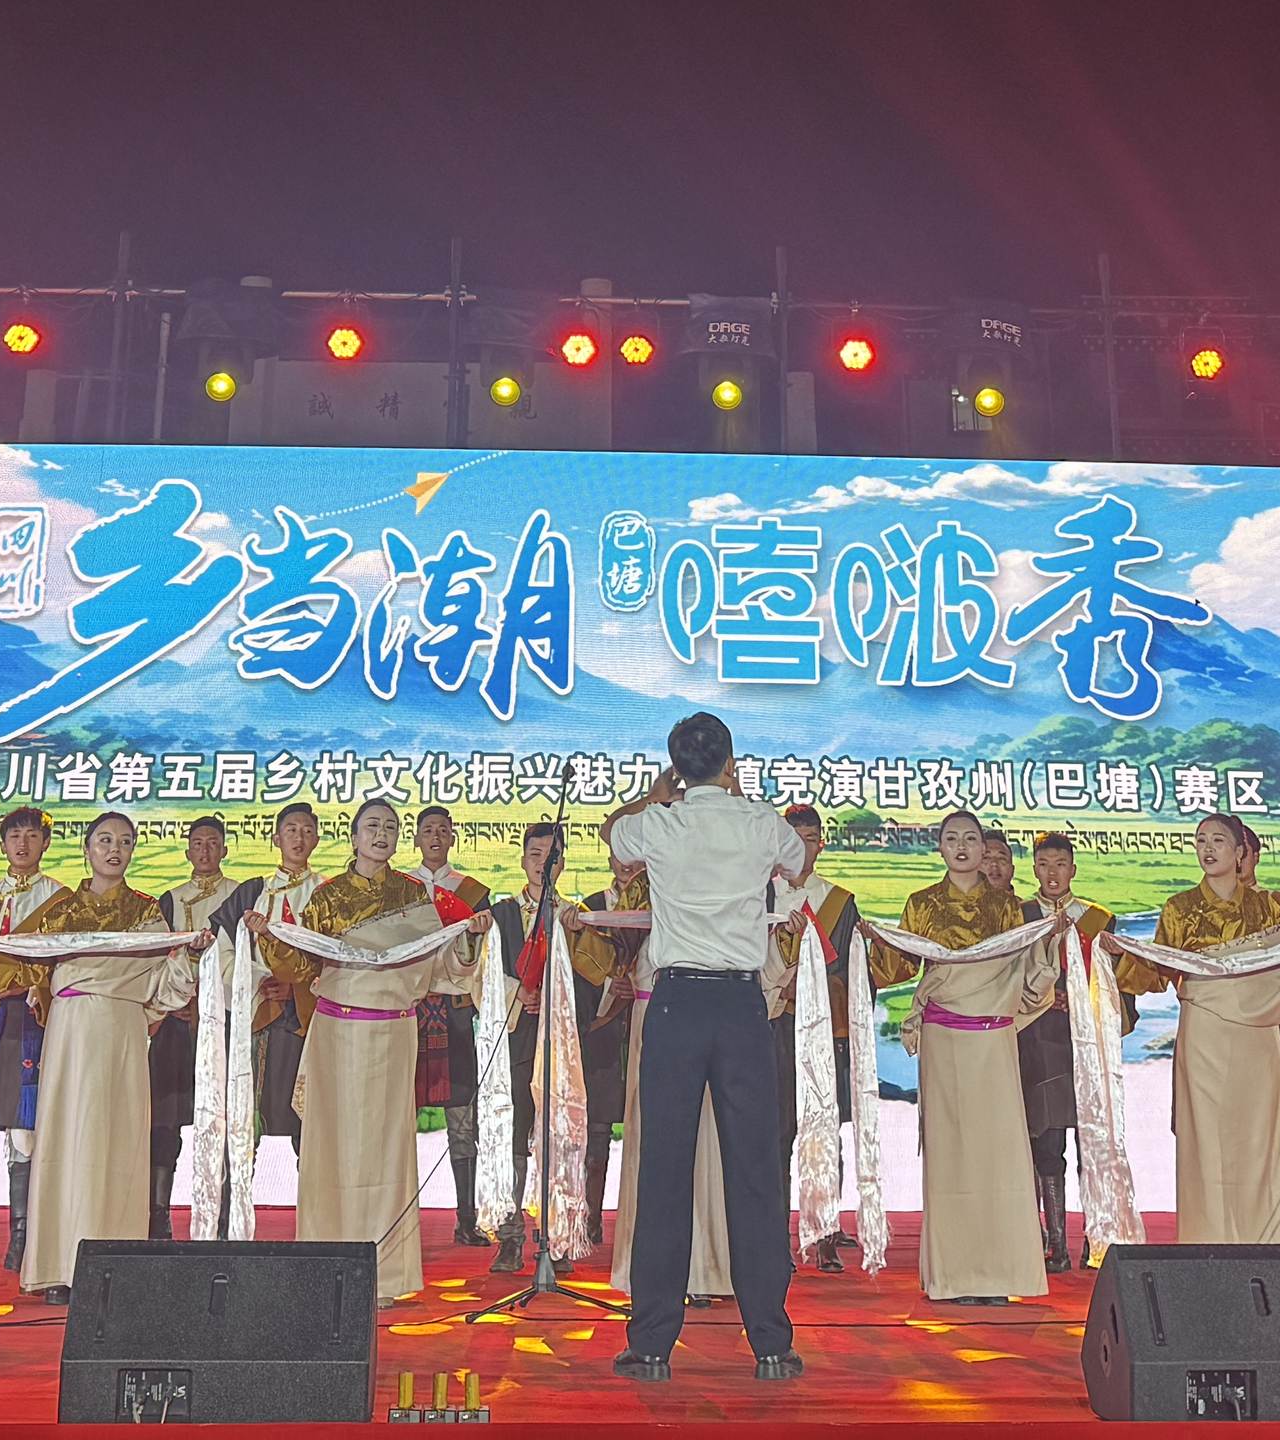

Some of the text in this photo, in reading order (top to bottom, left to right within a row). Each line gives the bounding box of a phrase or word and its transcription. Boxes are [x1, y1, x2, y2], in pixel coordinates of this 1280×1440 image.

[605, 517, 647, 598] 巴塘
[658, 494, 1212, 721] 嘻啵秀
